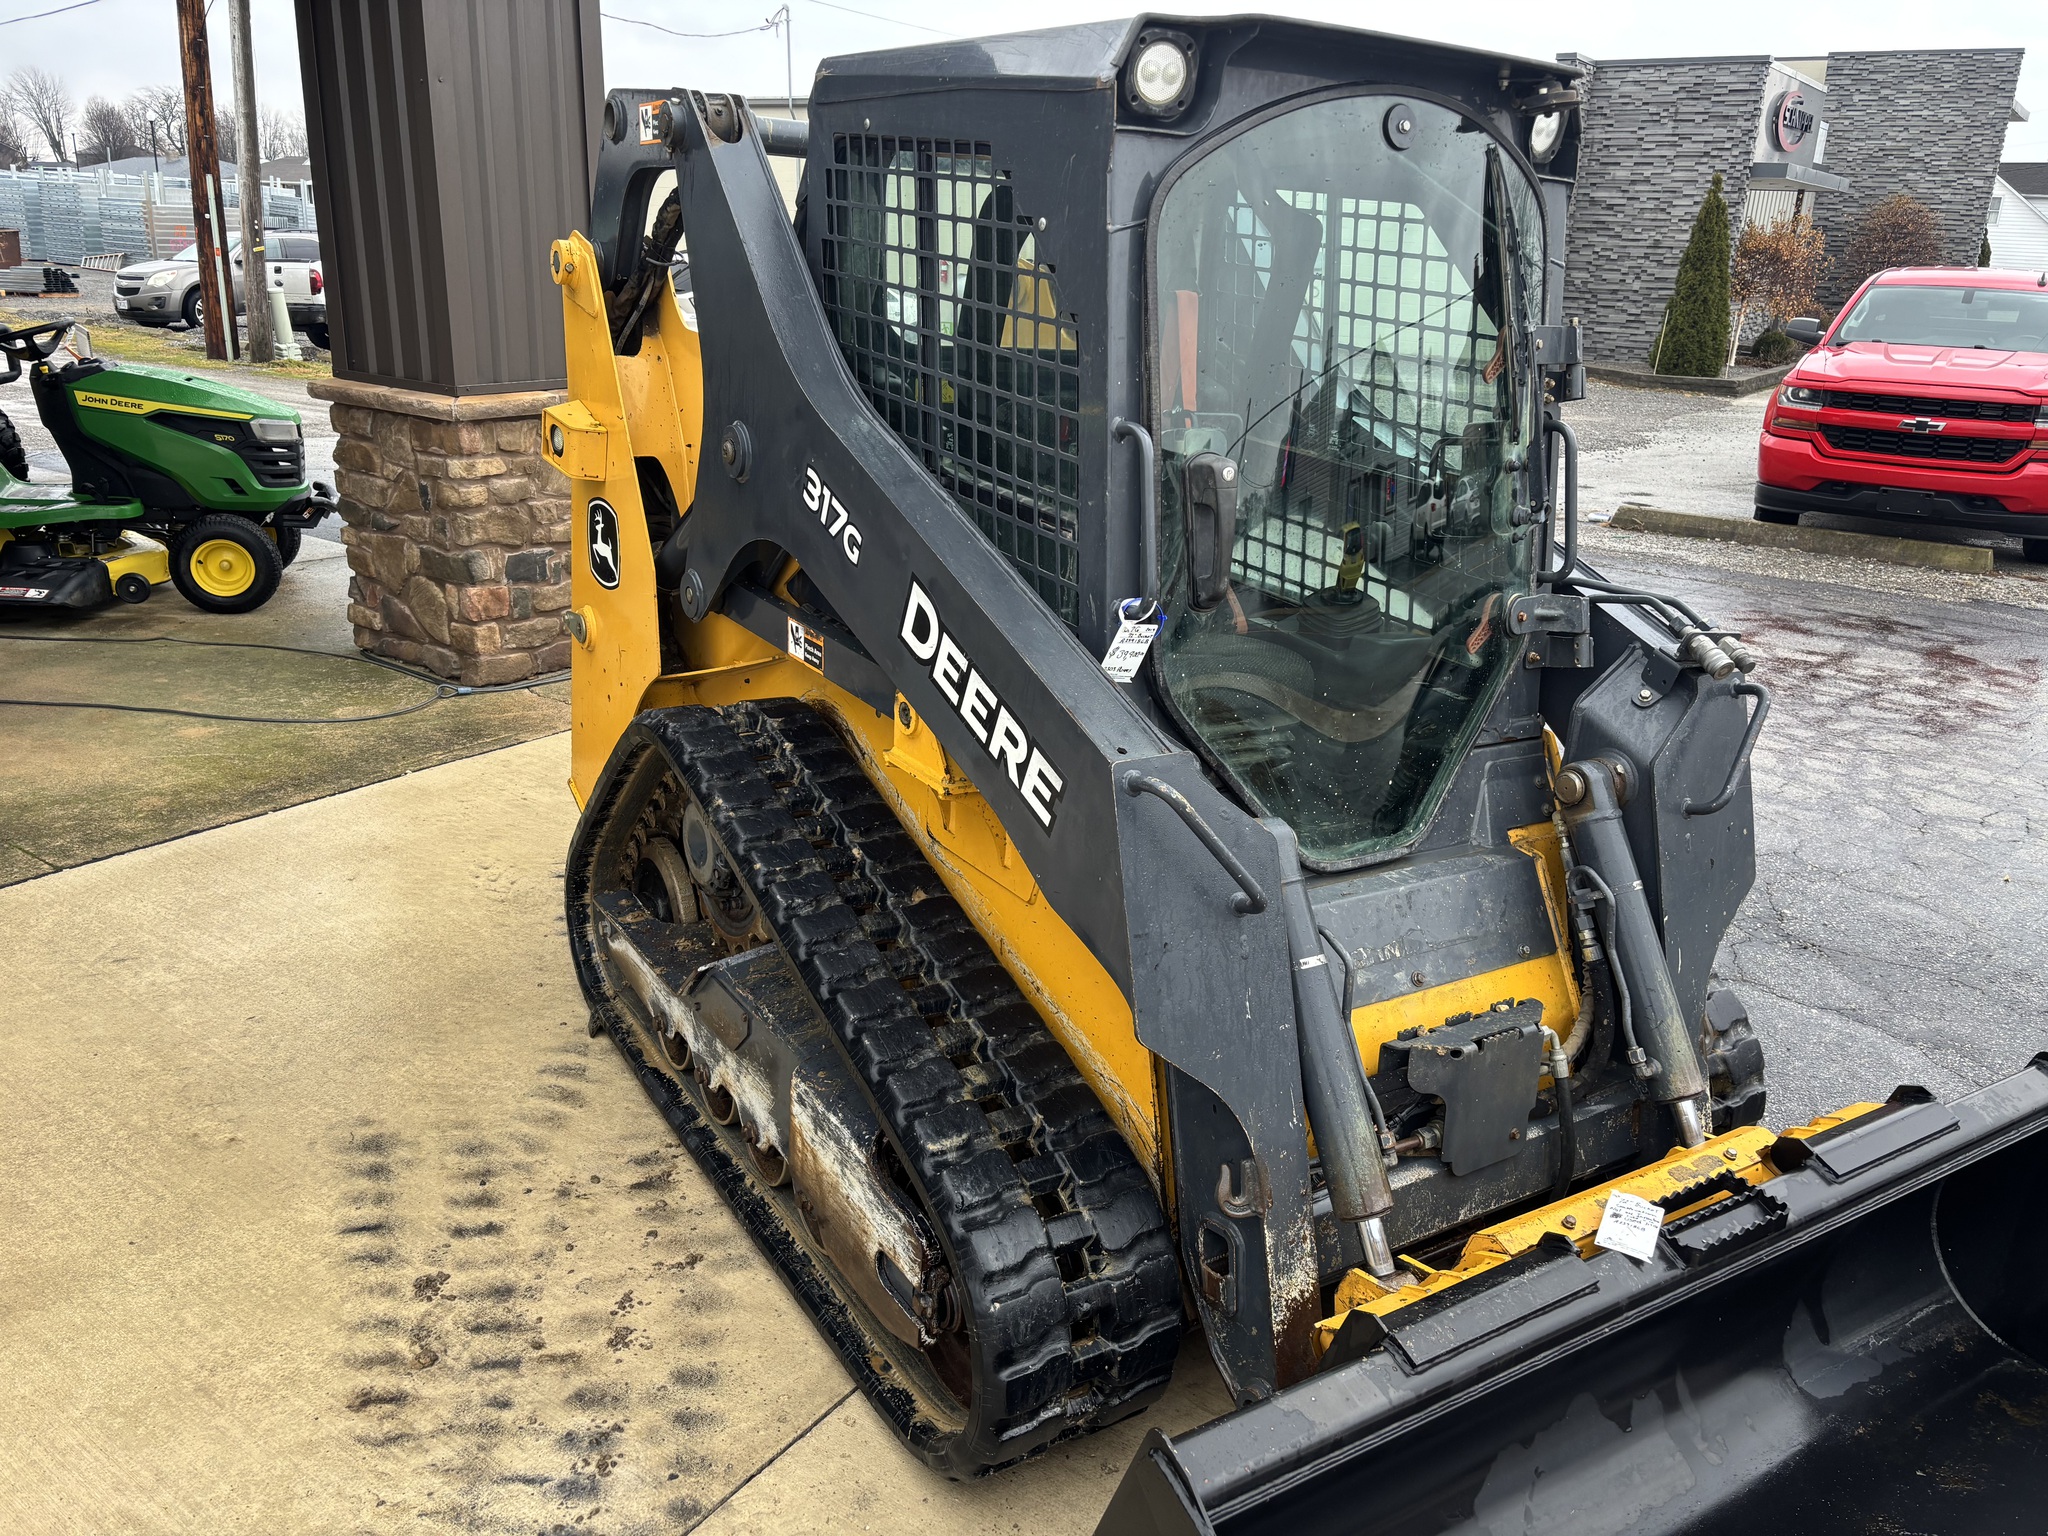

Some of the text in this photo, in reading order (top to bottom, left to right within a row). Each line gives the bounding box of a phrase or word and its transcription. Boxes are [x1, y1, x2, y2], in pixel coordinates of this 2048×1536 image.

[81, 394, 144, 410] JOHN DEERE
[214, 433, 235, 442] S170
[802, 467, 863, 565] 317G
[804, 642, 822, 658] Pinch Area
[901, 581, 1064, 827] DEERE
